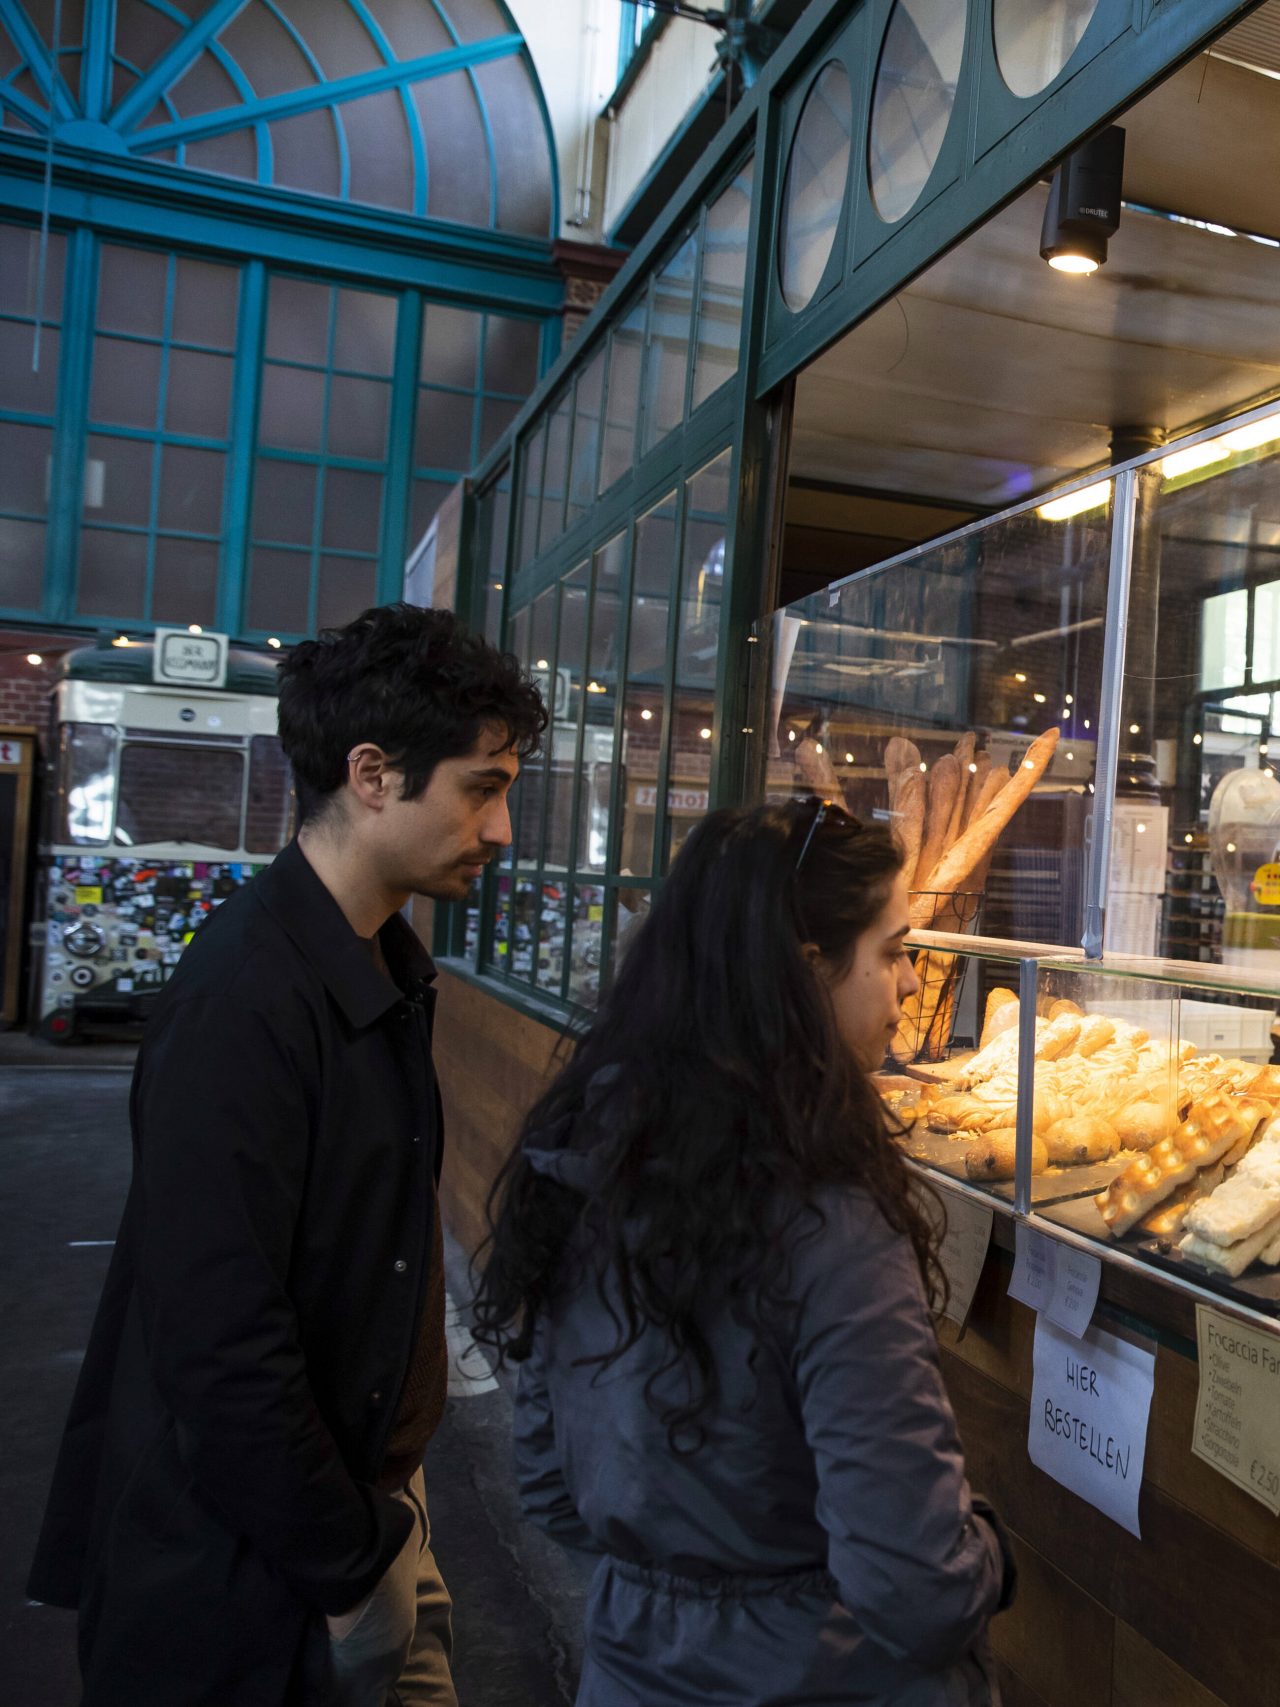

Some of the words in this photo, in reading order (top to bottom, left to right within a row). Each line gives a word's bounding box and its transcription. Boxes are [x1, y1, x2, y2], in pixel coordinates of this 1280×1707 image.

[1208, 1324, 1258, 1364] Focaccia
[1066, 1356, 1100, 1398] HIER
[1044, 1398, 1131, 1480] BESTELLEN
